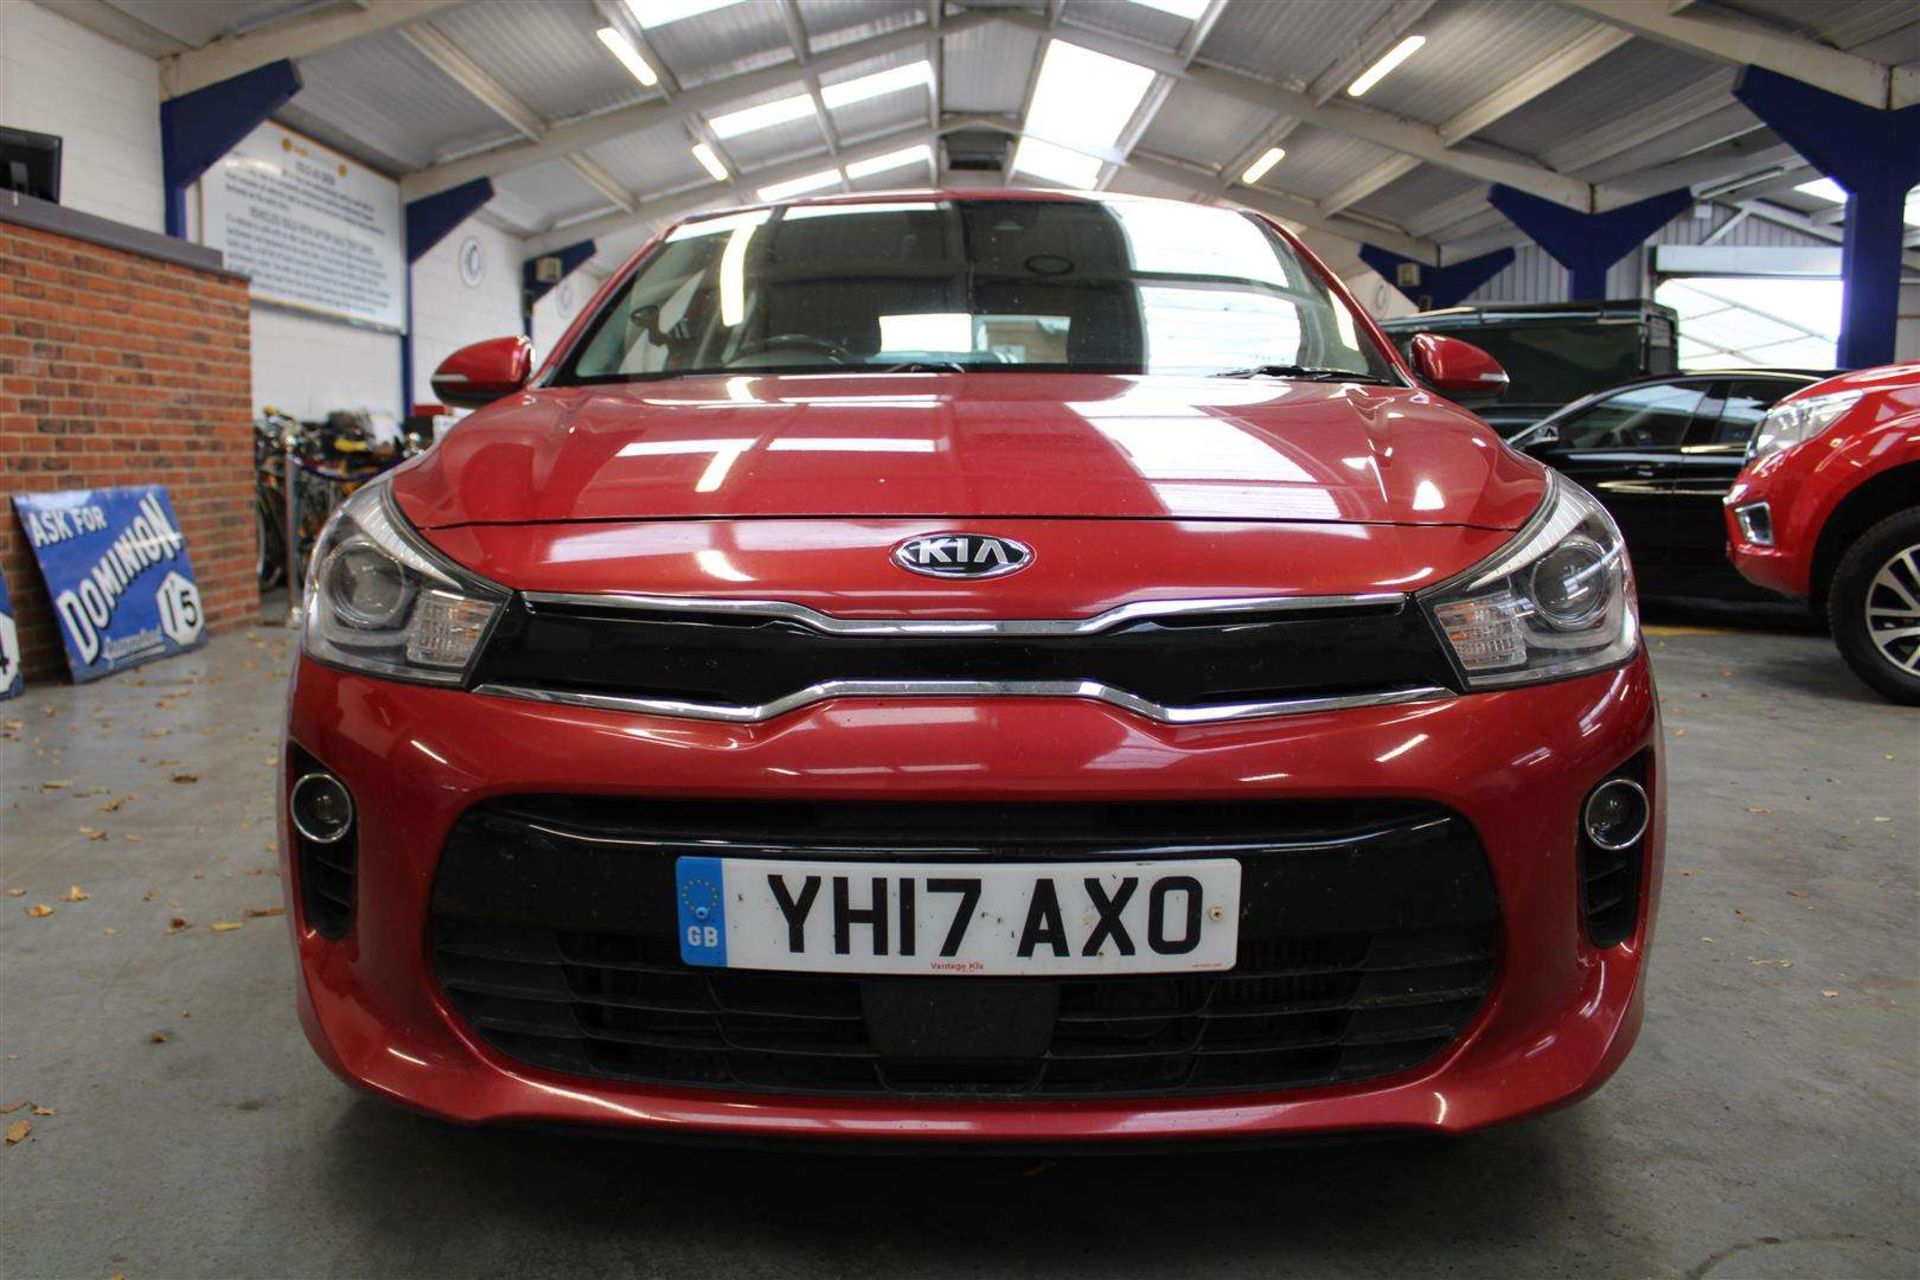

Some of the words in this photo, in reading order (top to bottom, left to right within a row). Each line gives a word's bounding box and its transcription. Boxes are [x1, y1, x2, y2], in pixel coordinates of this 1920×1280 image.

[27, 508, 73, 547] ASK
[70, 505, 108, 534] FOR
[918, 537, 1009, 564] KIA
[56, 492, 183, 664] DOMINION
[767, 873, 983, 957] YH17
[1016, 875, 1204, 957] AXO
[687, 925, 718, 948] GB
